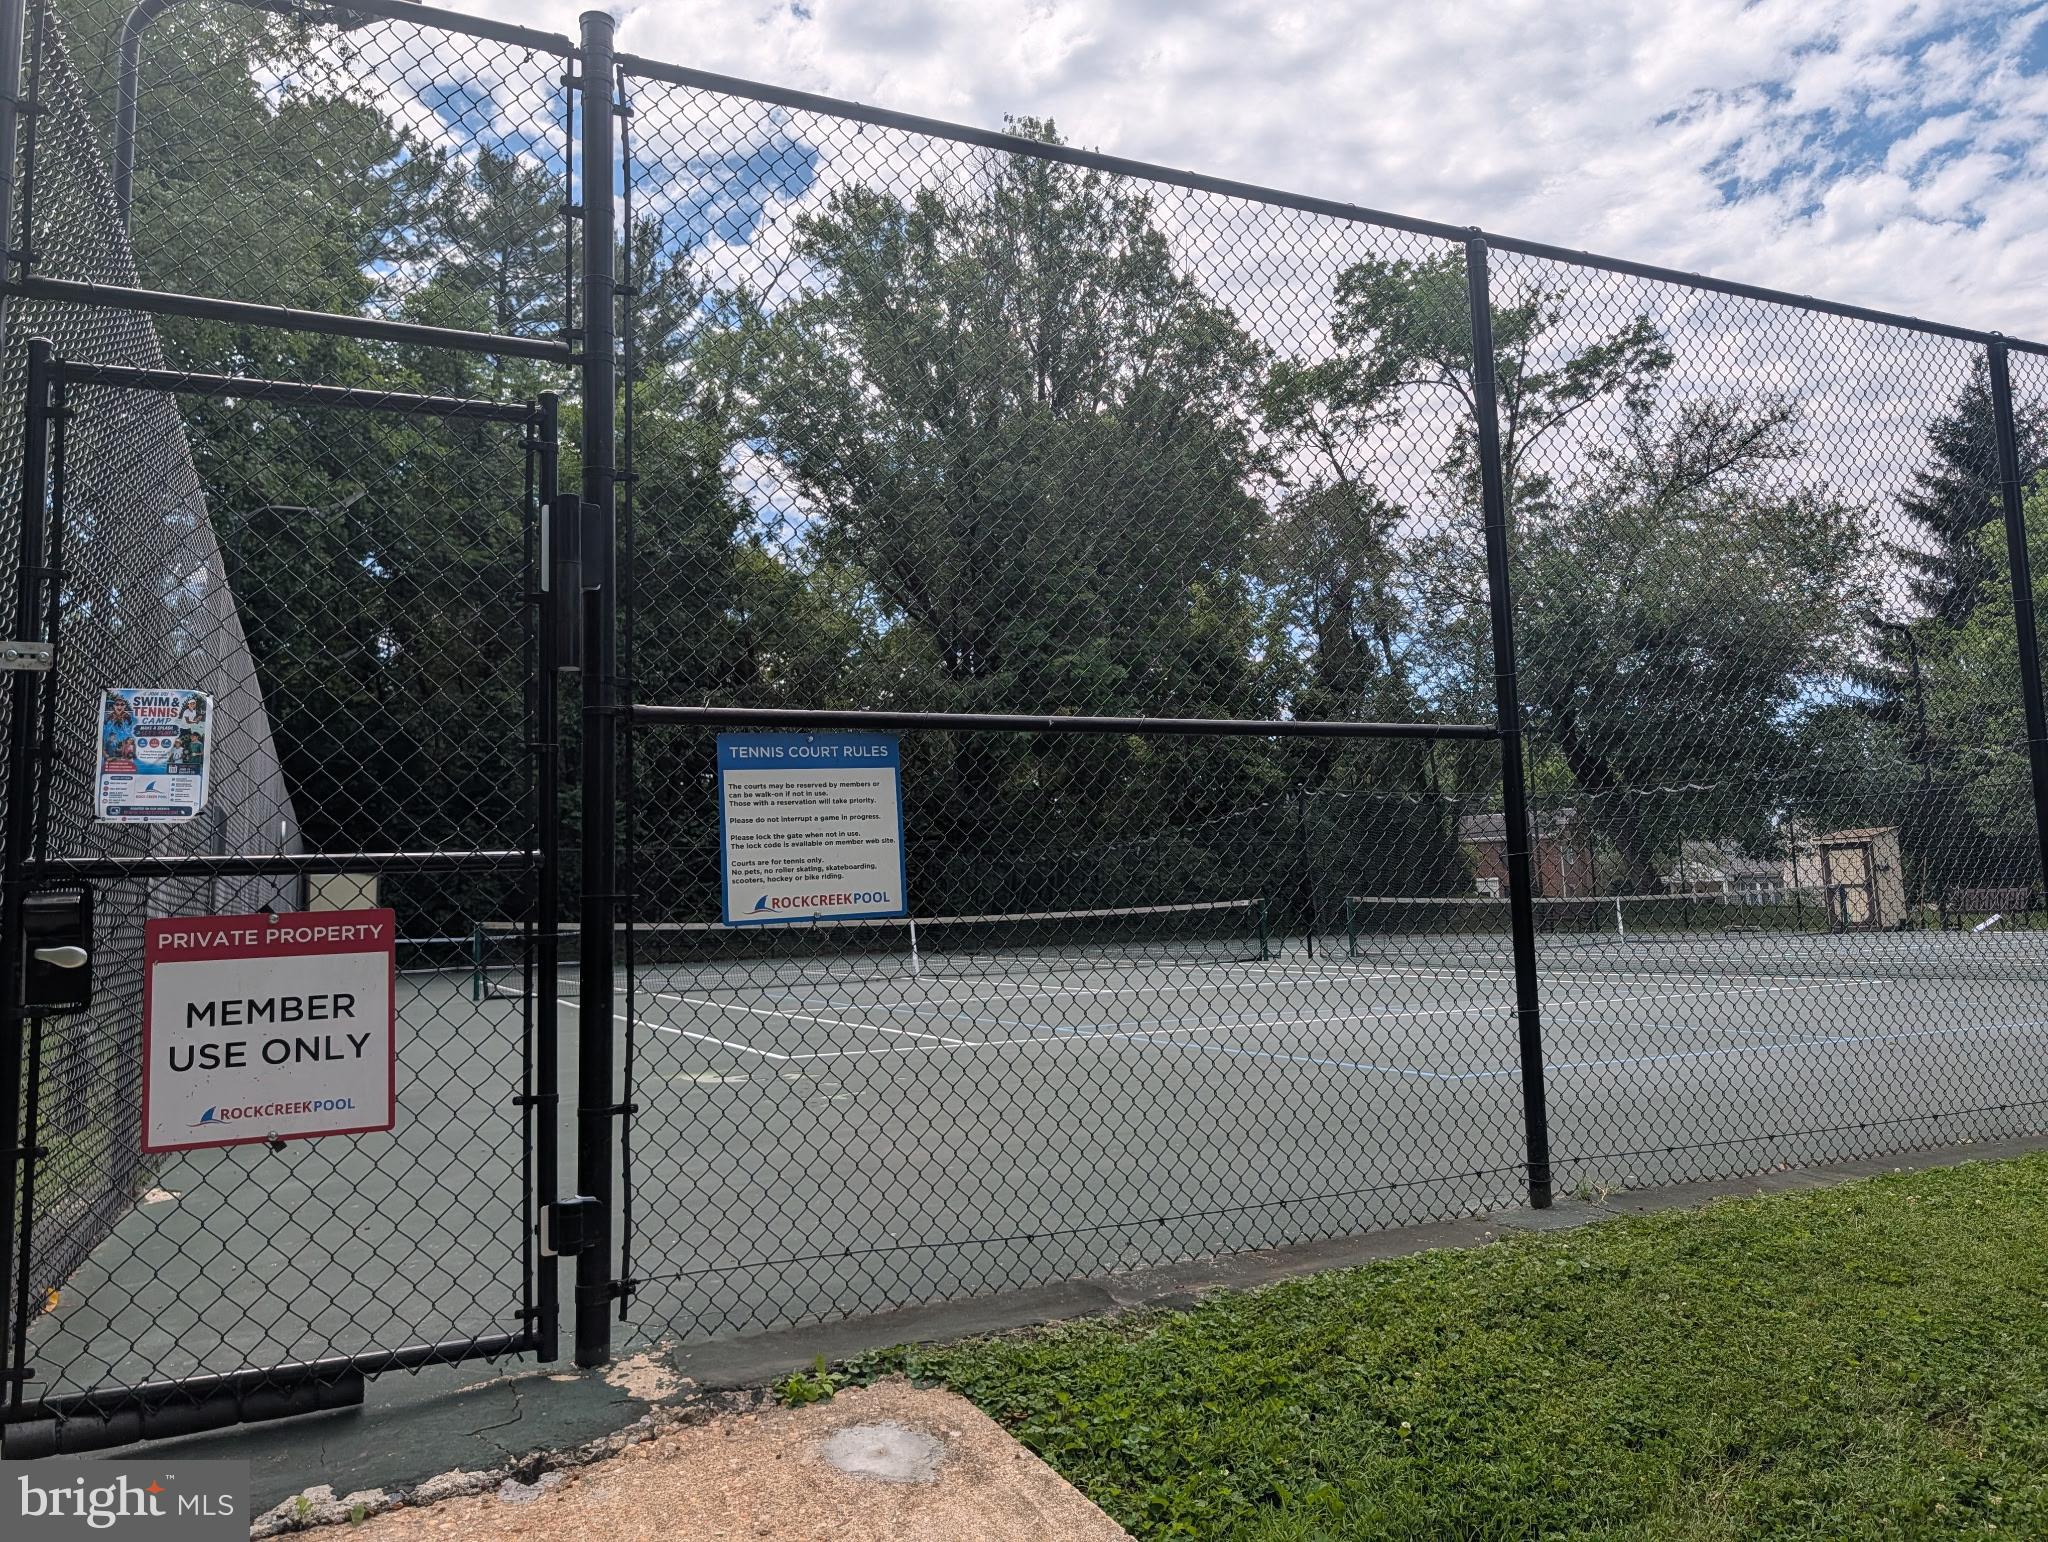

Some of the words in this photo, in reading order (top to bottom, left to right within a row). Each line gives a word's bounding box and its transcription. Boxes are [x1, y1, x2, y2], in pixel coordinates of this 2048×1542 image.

[133, 697, 169, 706] SWIM
[171, 698, 179, 707] &
[133, 707, 178, 717] TENNIS
[729, 747, 784, 758] TENNIS
[789, 746, 838, 757] COURT
[844, 746, 888, 756] RULES
[796, 865, 824, 873] skating,
[772, 892, 890, 909] ROCKCREEKPOOL
[158, 930, 258, 949] PRIVATE
[266, 924, 383, 944] PROPERTY
[187, 994, 355, 1028] MEMBER
[170, 1041, 246, 1072] USE
[262, 1033, 371, 1064] ONLY
[221, 1098, 355, 1120] ROCKCREEKPOOL
